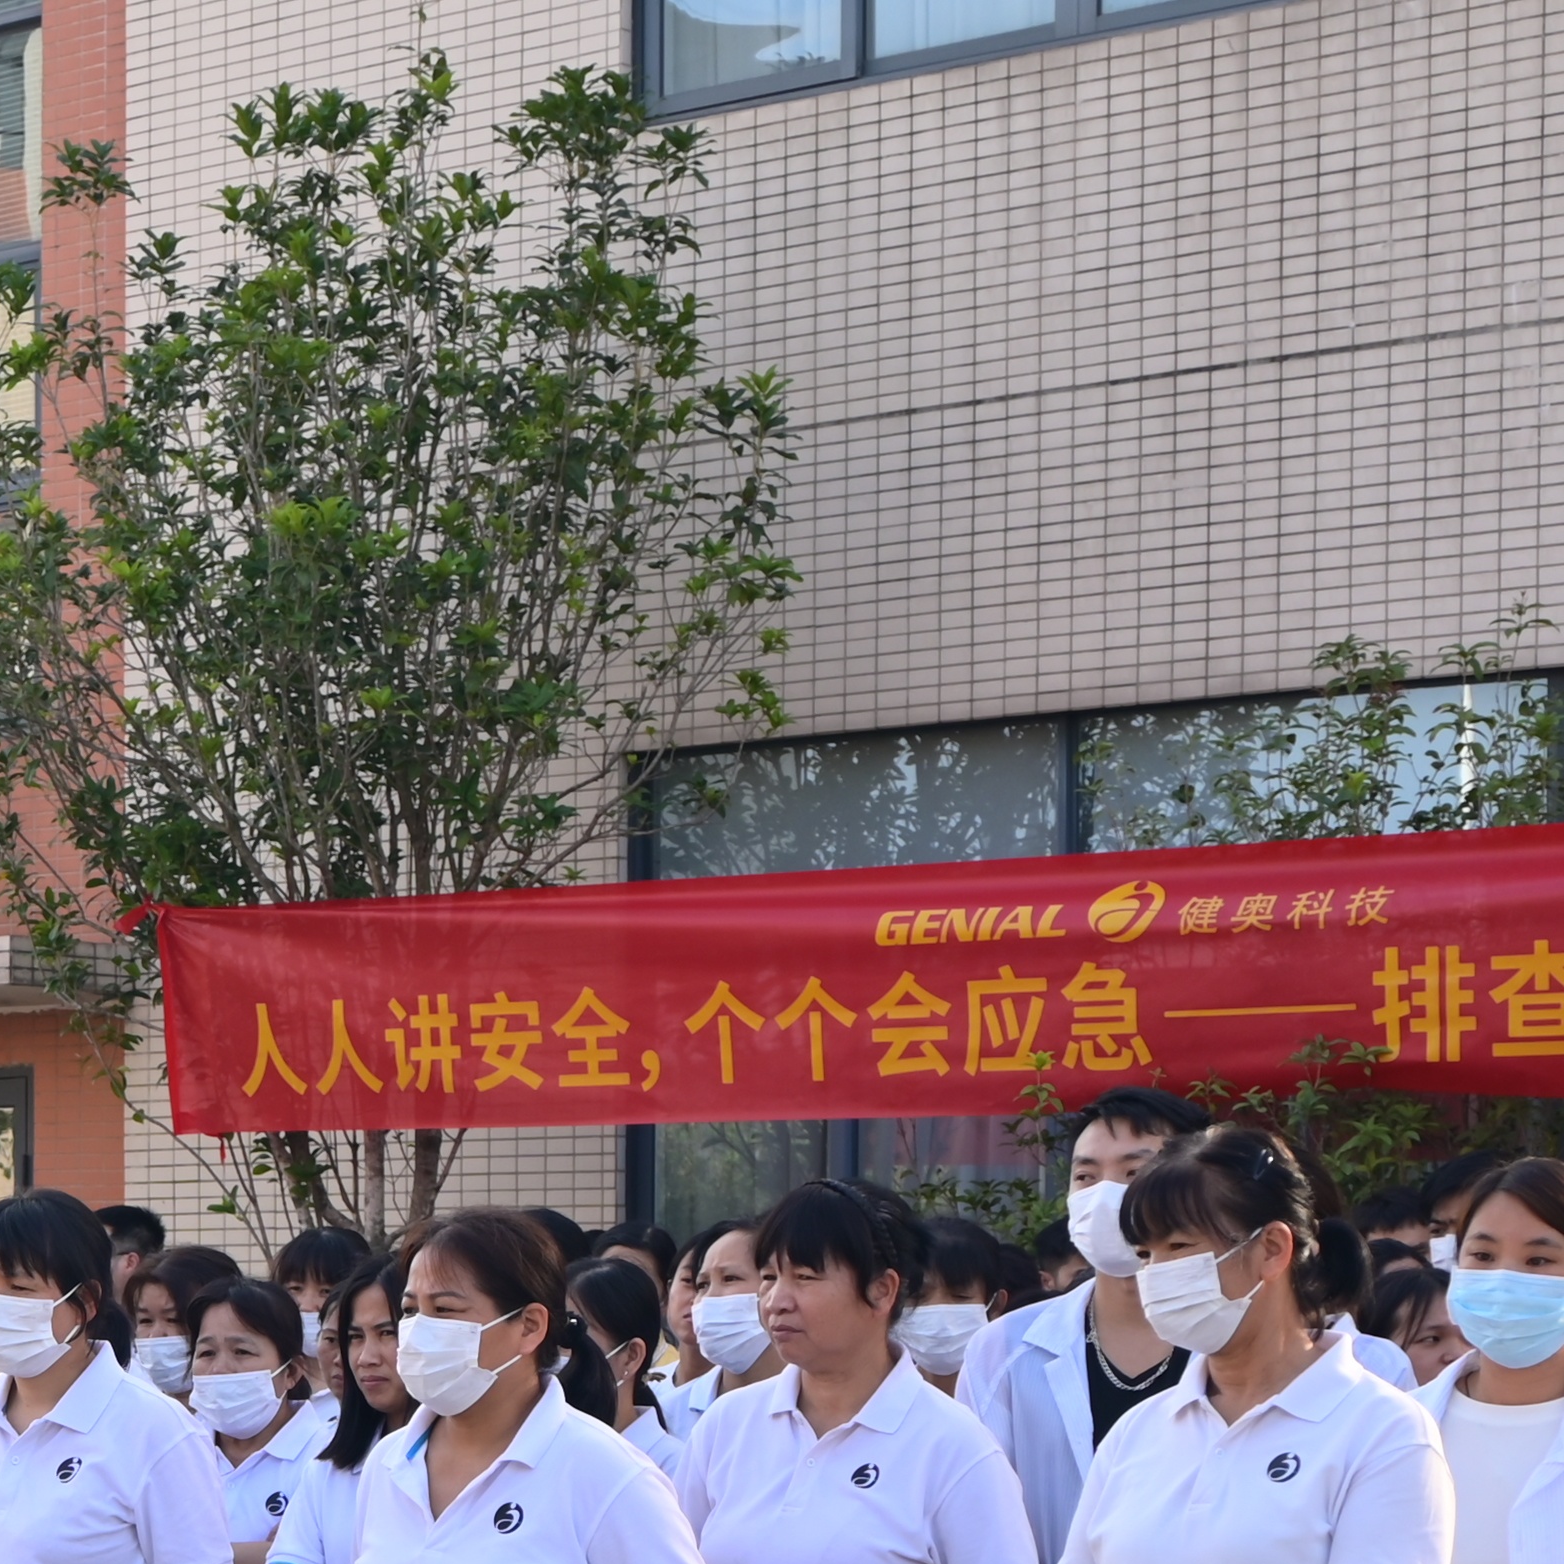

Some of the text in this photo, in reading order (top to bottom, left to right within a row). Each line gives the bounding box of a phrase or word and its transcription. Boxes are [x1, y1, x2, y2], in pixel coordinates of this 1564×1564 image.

[874, 905, 1067, 947] GENIAL
[1177, 885, 1394, 935] 健奥科技
